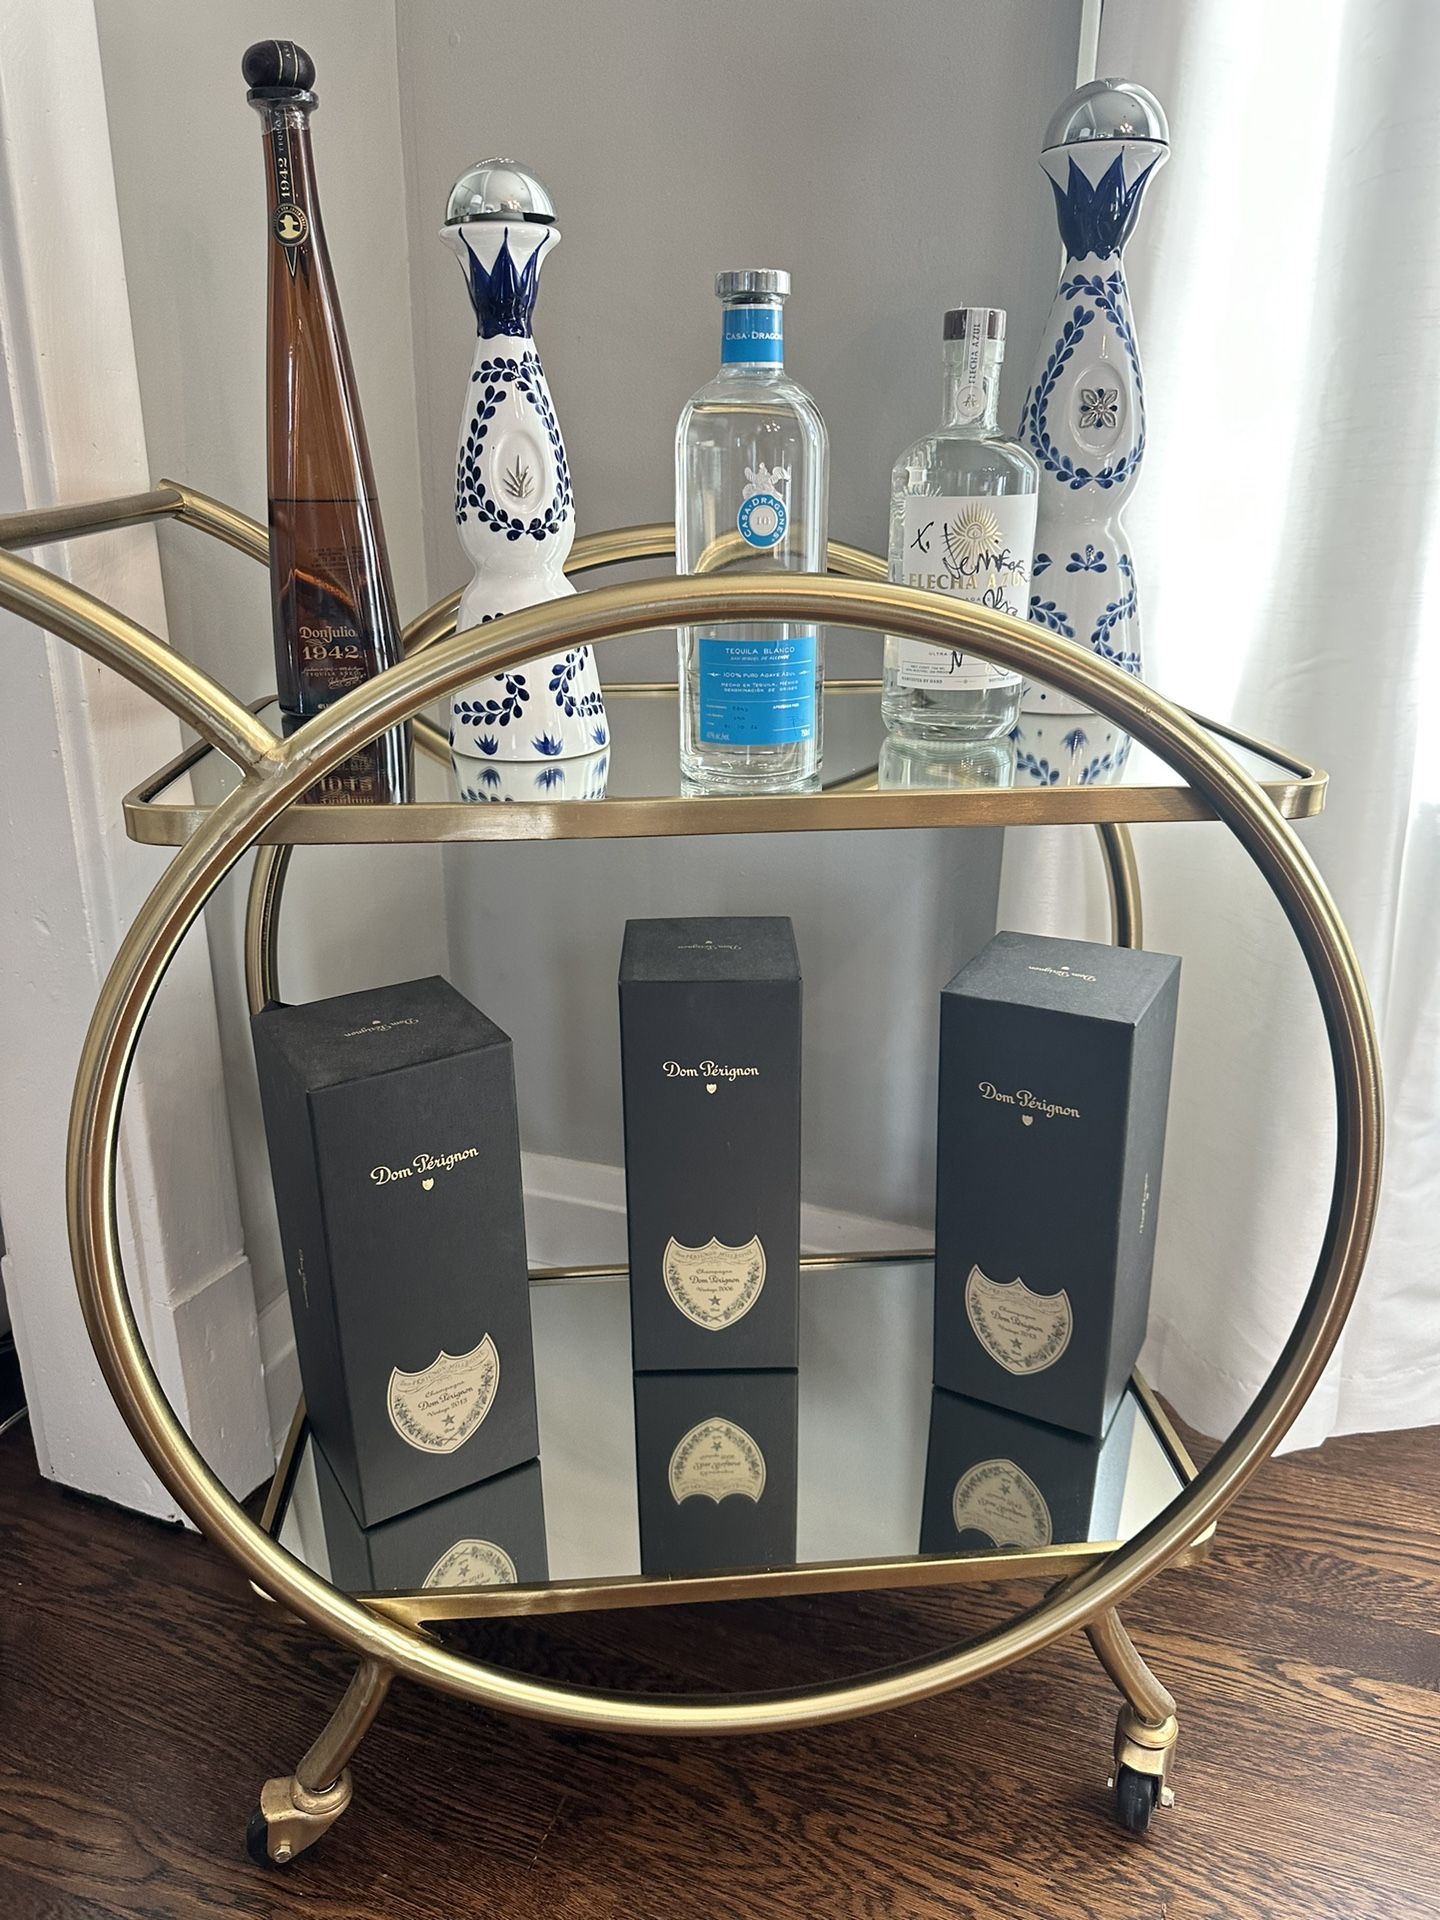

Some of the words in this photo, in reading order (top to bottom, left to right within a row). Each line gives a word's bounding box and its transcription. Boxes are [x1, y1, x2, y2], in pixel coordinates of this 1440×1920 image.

[278, 157, 291, 199] 1942
[972, 323, 981, 347] AZUL
[968, 350, 979, 384] FLECHA
[302, 645, 359, 660] 1942
[662, 1061, 699, 1077] Dom
[699, 1060, 760, 1082] Pérignon
[978, 1081, 1016, 1104] Dom
[1016, 1089, 1081, 1118] Pérignon
[370, 1166, 413, 1186] Dom
[412, 1147, 480, 1174] Pérignon
[418, 1400, 440, 1411] Dom
